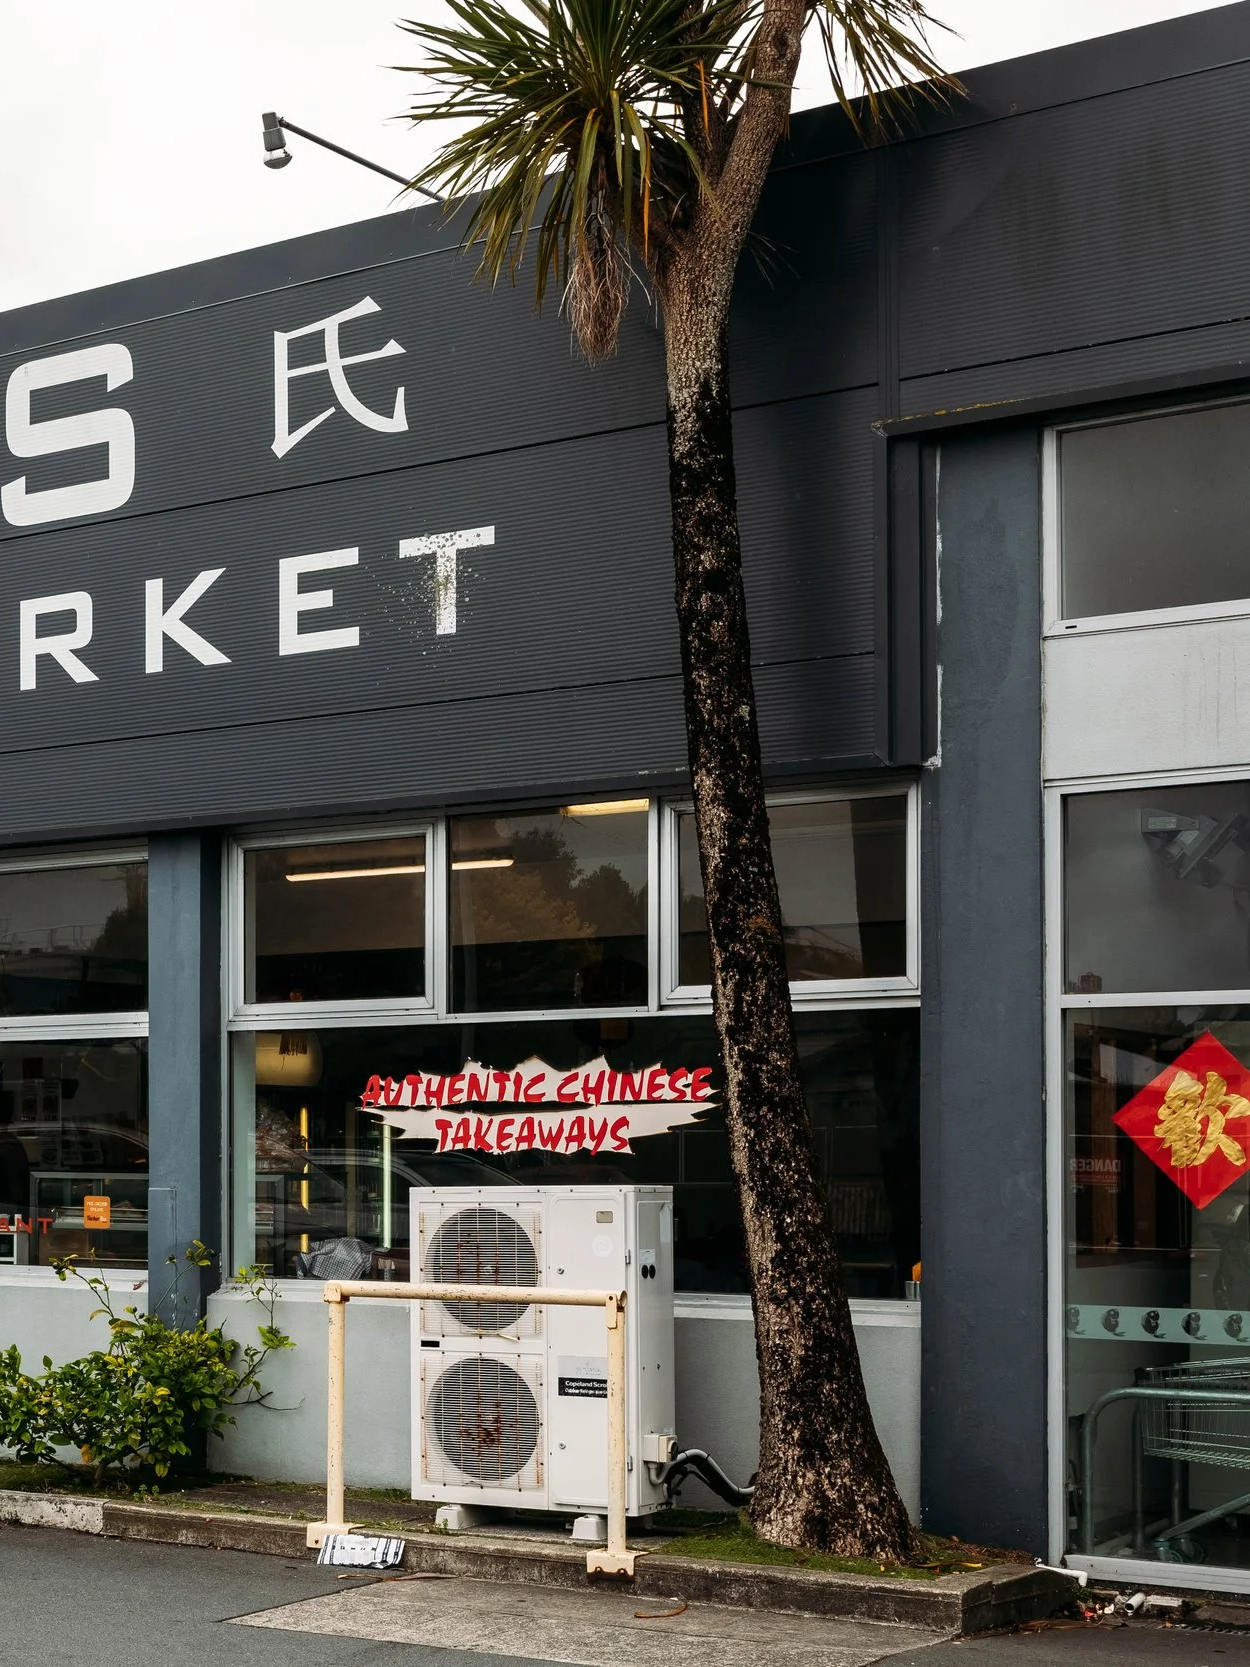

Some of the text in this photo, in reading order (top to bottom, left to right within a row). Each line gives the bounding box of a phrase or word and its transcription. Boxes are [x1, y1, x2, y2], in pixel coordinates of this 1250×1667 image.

[271, 296, 409, 459] 氏
[361, 1066, 713, 1110] AUTHENTIC CHINESE
[435, 1115, 630, 1156] TAKEAWAYS
[565, 1380, 593, 1388] Copeland
